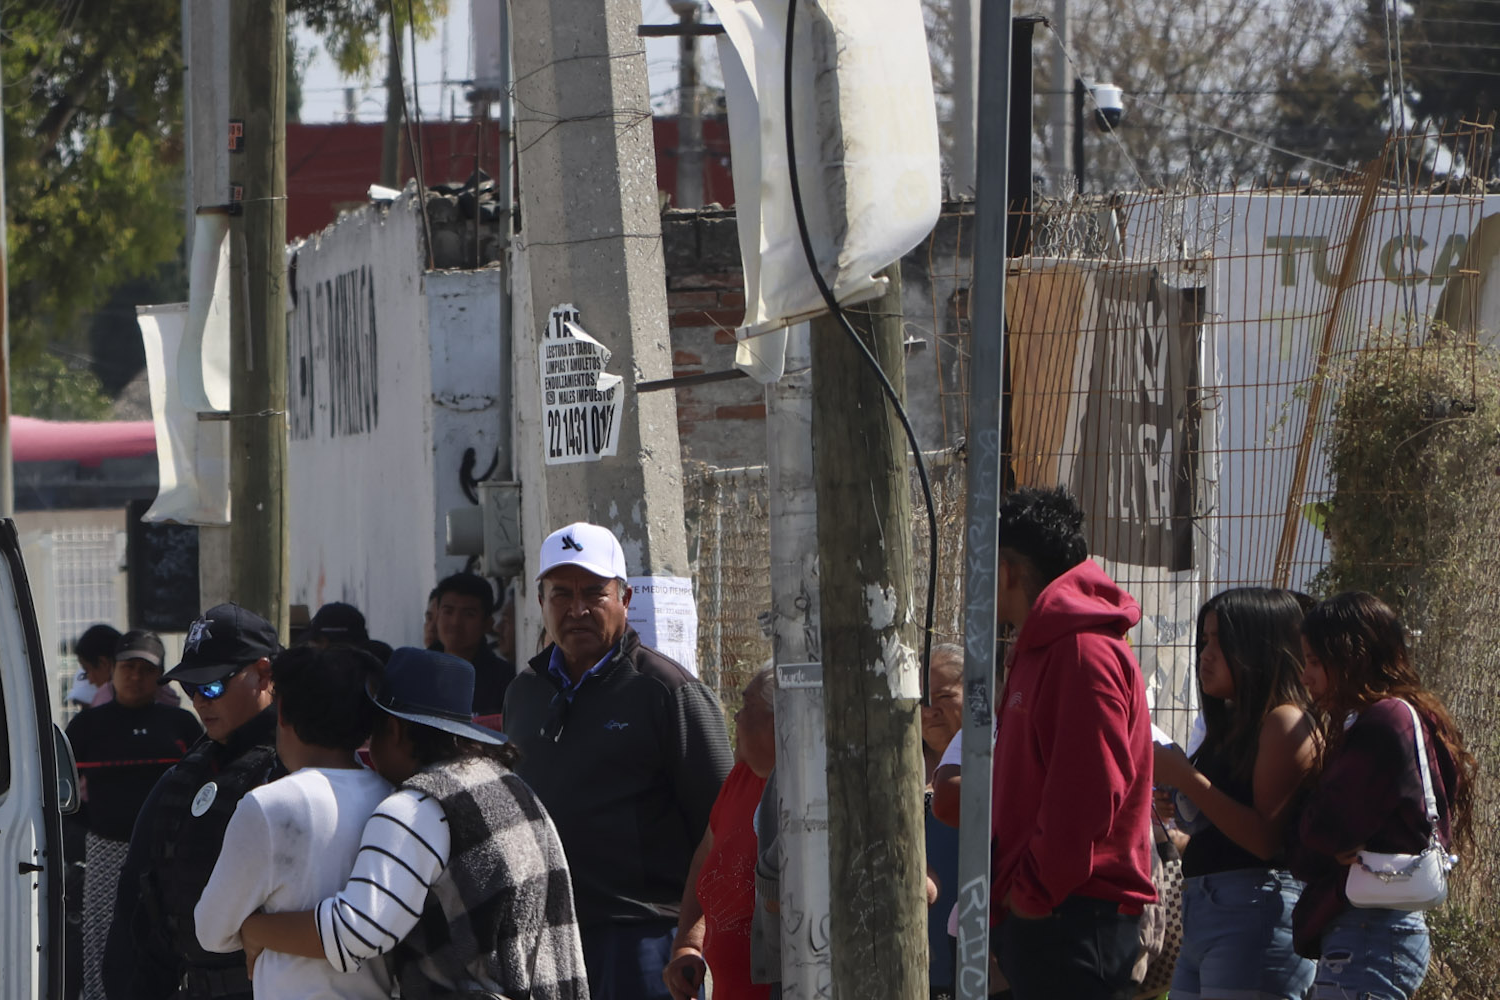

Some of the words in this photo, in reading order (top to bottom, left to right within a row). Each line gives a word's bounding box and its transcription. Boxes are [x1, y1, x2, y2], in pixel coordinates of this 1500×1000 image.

[546, 343, 567, 359] LECTURA
[568, 342, 575, 357] DE
[545, 359, 566, 375] LIMPIAS
[570, 356, 601, 372] AMULETOS
[558, 390, 576, 405] MALES
[577, 388, 615, 403] IMPUESTOS
[548, 409, 562, 458] 22
[563, 406, 589, 456] 1431
[642, 585, 668, 594] MEDIO
